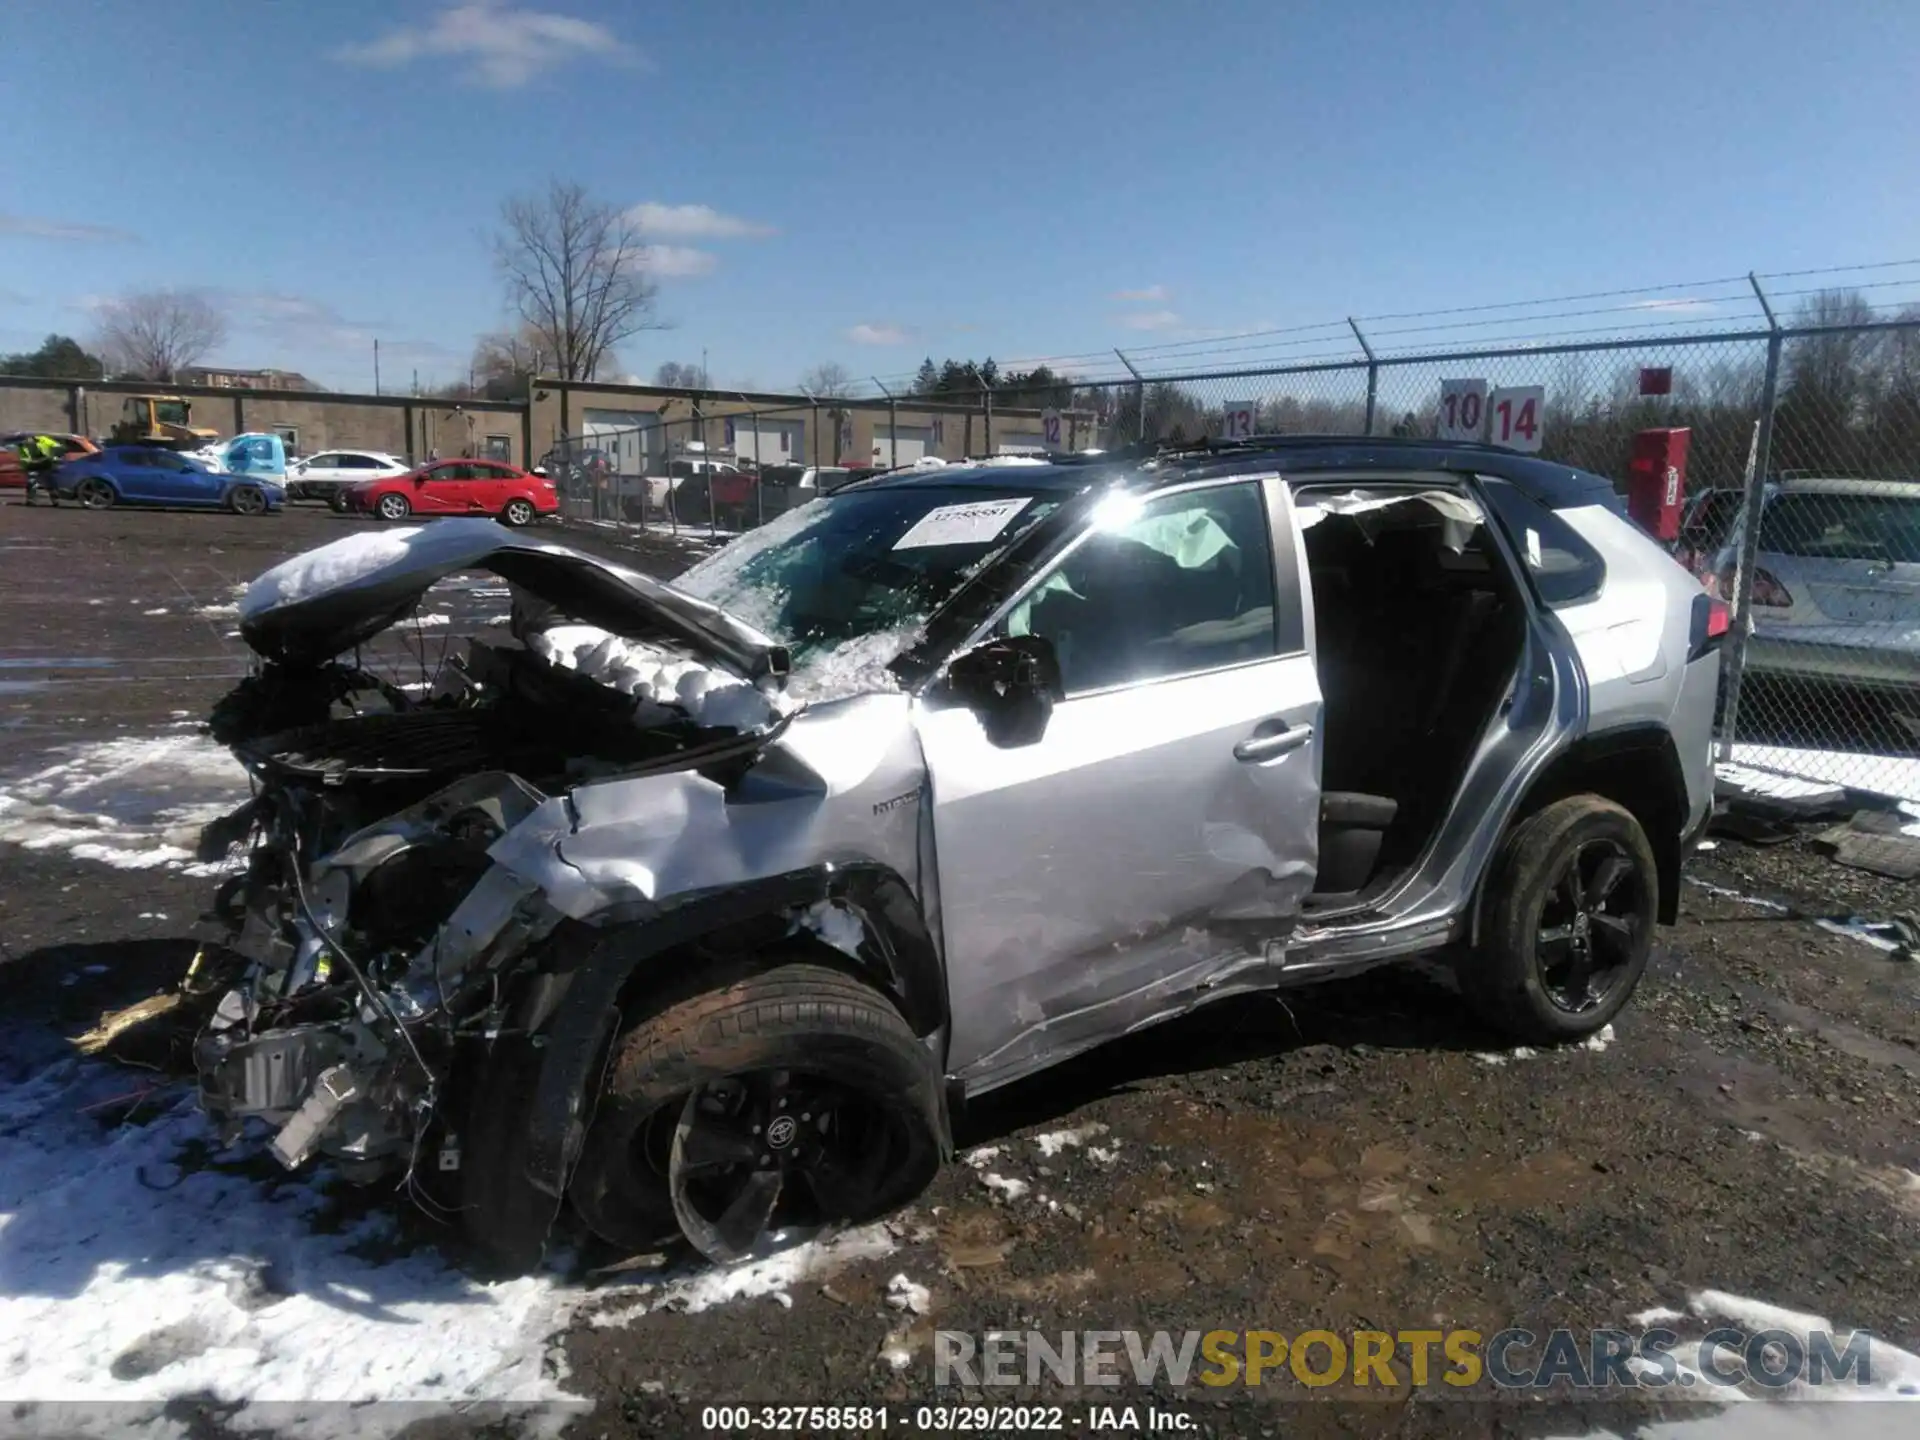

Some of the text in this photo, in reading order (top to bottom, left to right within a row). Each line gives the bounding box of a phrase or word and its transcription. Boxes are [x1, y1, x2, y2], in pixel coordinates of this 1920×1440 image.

[1226, 410, 1250, 437] 13
[1444, 391, 1480, 431] 10
[1496, 397, 1538, 442] 14
[1042, 415, 1061, 444] 12
